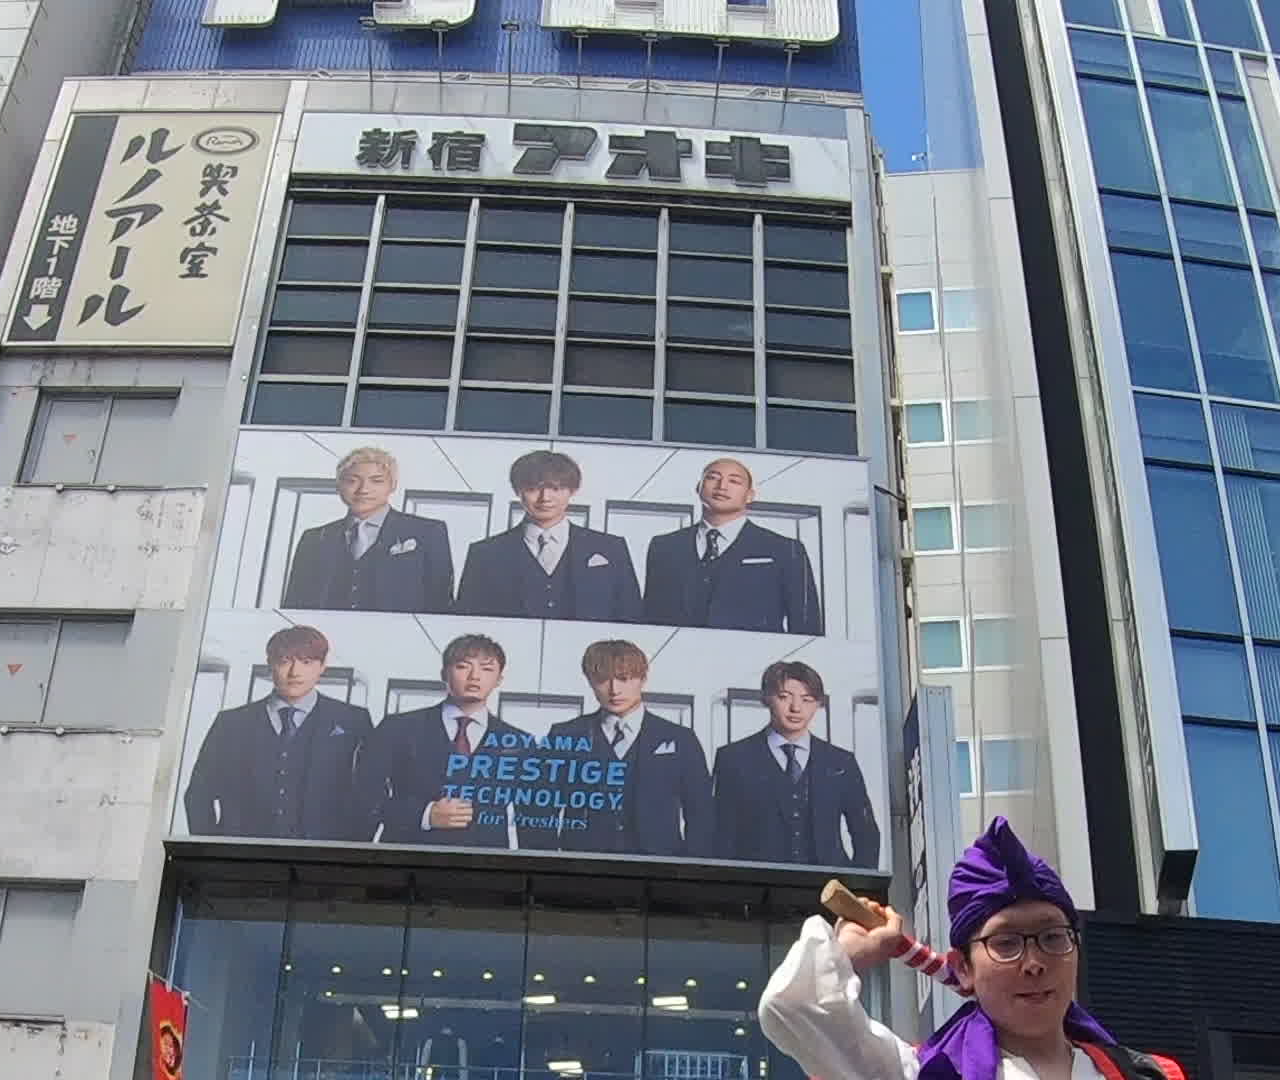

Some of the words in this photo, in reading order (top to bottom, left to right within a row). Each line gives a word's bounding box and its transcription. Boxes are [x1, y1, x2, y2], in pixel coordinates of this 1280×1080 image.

[356, 124, 792, 189] 新宿アオキ
[77, 127, 185, 327] ルノアール
[177, 162, 239, 280] 喫茶室
[28, 214, 81, 300] 地下1階
[484, 732, 592, 752] AOYAMA
[446, 754, 628, 786] PRESTIGE
[441, 783, 624, 812] TECHNOLOGY
[477, 810, 504, 825] for
